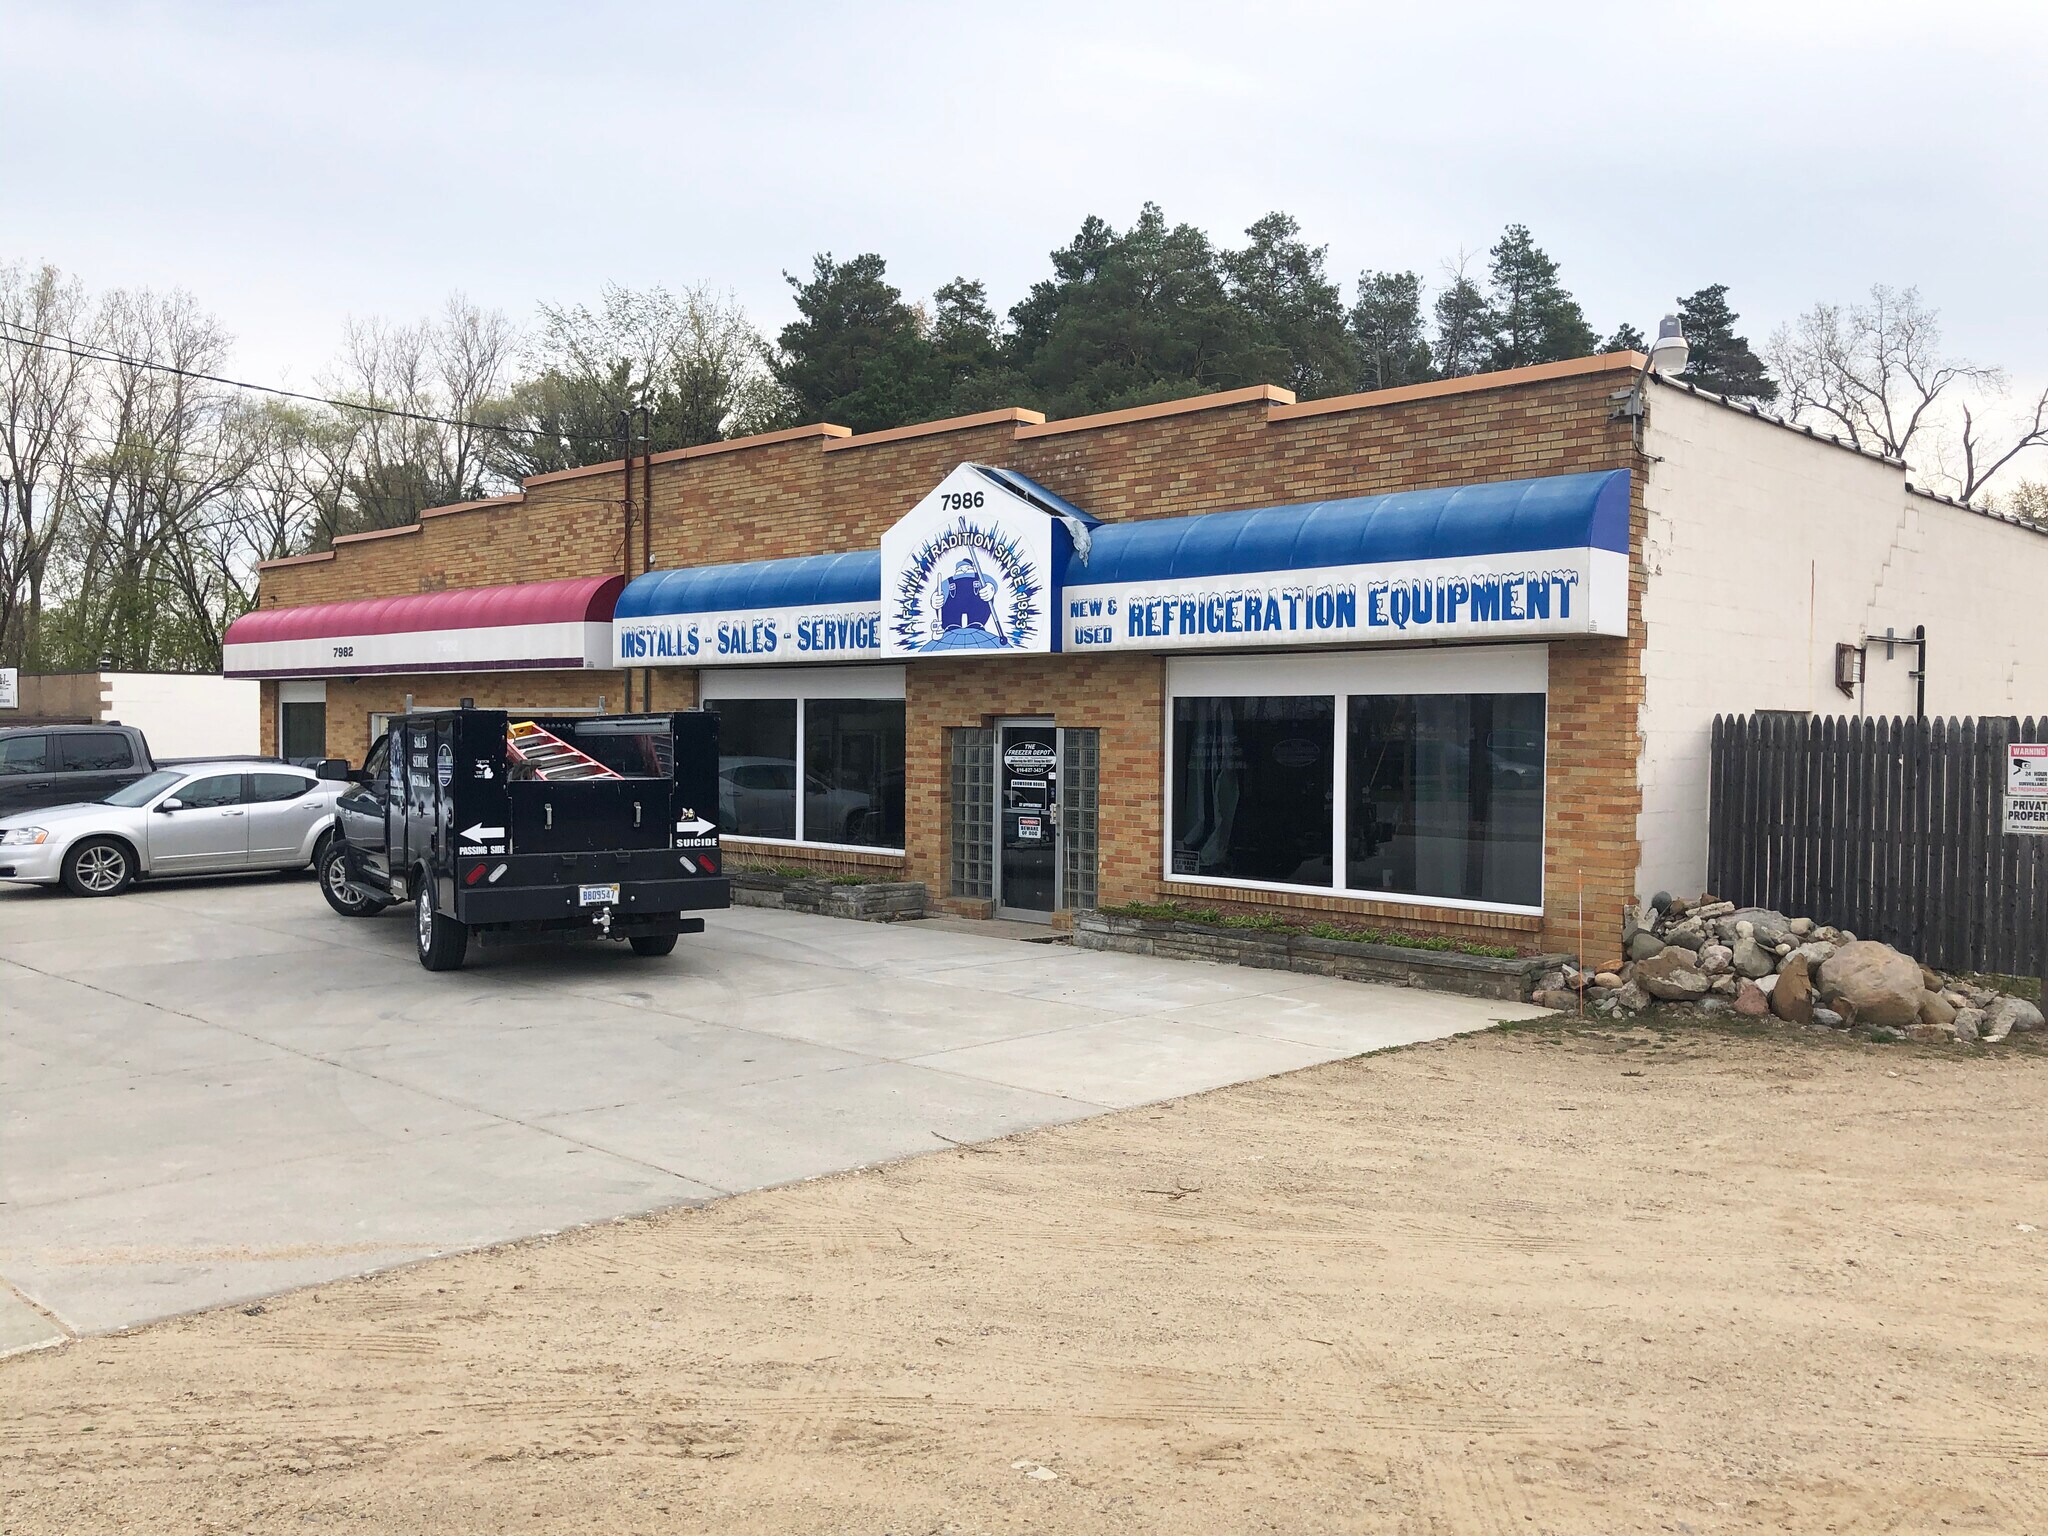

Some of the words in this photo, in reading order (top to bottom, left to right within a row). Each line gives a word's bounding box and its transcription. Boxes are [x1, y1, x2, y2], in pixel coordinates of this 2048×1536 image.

[941, 491, 984, 511] 7986
[924, 531, 994, 564] TRADITION
[995, 544, 1026, 589] SINCE
[902, 563, 926, 619] FAMILY
[1015, 592, 1030, 630] 1933
[1070, 598, 1104, 618] NEW
[1107, 596, 1117, 615] &
[1128, 583, 1357, 638] REFRIGERATION
[1367, 568, 1579, 630] EQUIPMENT
[621, 622, 699, 658] INSTALLS
[717, 618, 777, 655] SALES
[797, 611, 881, 651] SERVICE
[905, 622, 916, 634] A
[1075, 625, 1112, 644] USED
[333, 646, 354, 658] 7982
[414, 734, 428, 749] SALES
[2013, 747, 2046, 756] WARNING
[2013, 800, 2048, 811] PRIVAT
[459, 846, 487, 855] PASSING
[490, 845, 505, 854] SIDE
[676, 838, 717, 847] SUICIDE
